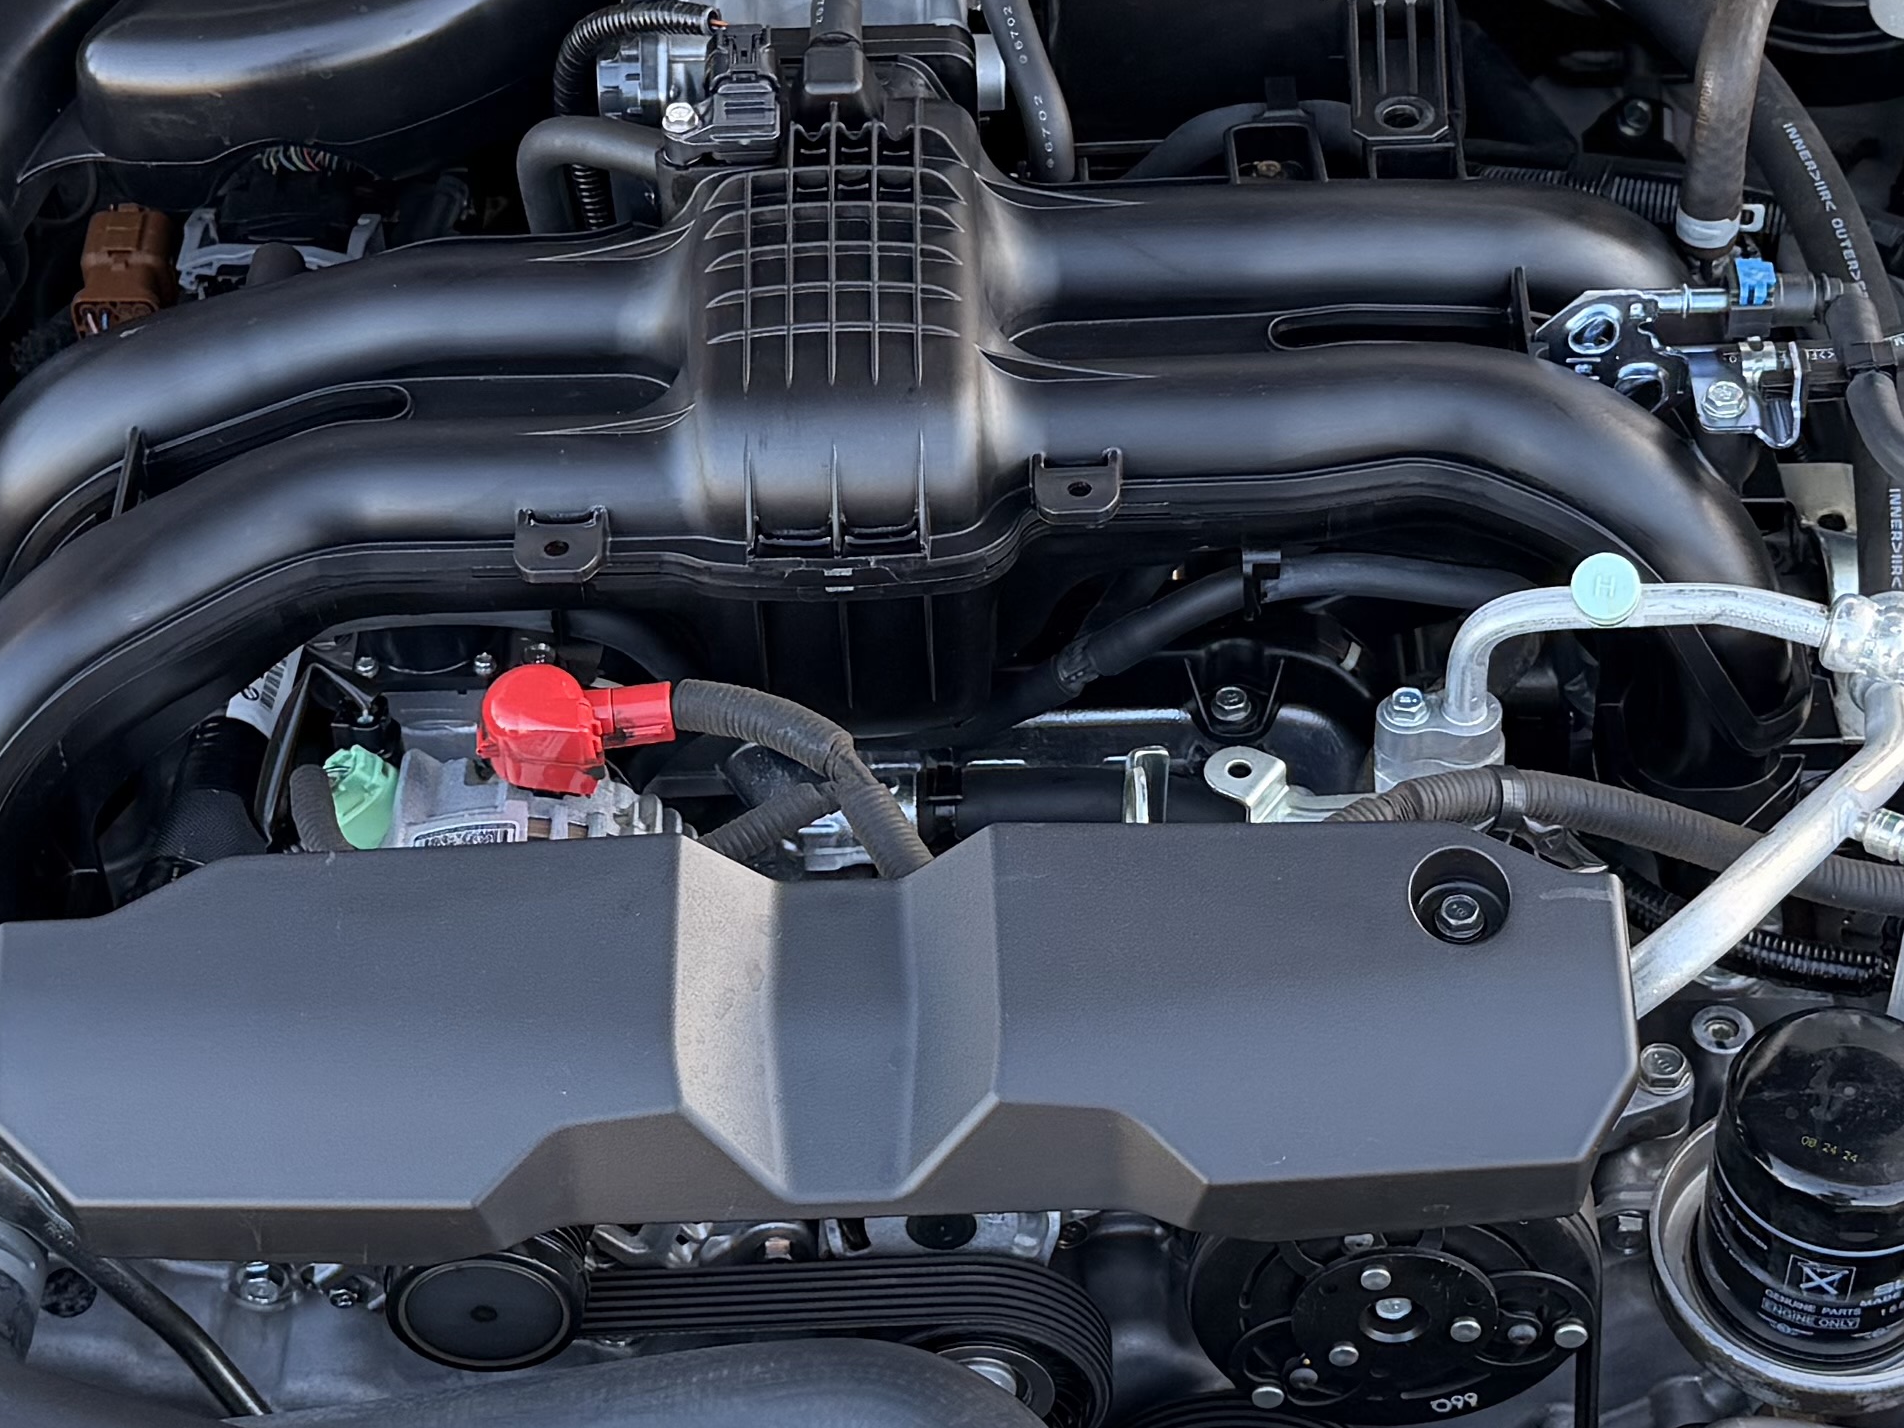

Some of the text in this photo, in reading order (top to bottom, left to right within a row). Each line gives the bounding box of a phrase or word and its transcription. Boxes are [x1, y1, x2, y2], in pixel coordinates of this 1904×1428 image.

[1783, 122, 1837, 212] INNER>IIR<
[1889, 488, 1904, 589] INNER>IIR<
[1593, 575, 1617, 598] H
[1765, 1288, 1861, 1317] GENUINE PARTS
[1859, 1291, 1901, 1308] MADE
[1764, 1301, 1856, 1329] ENGINE ONLY
